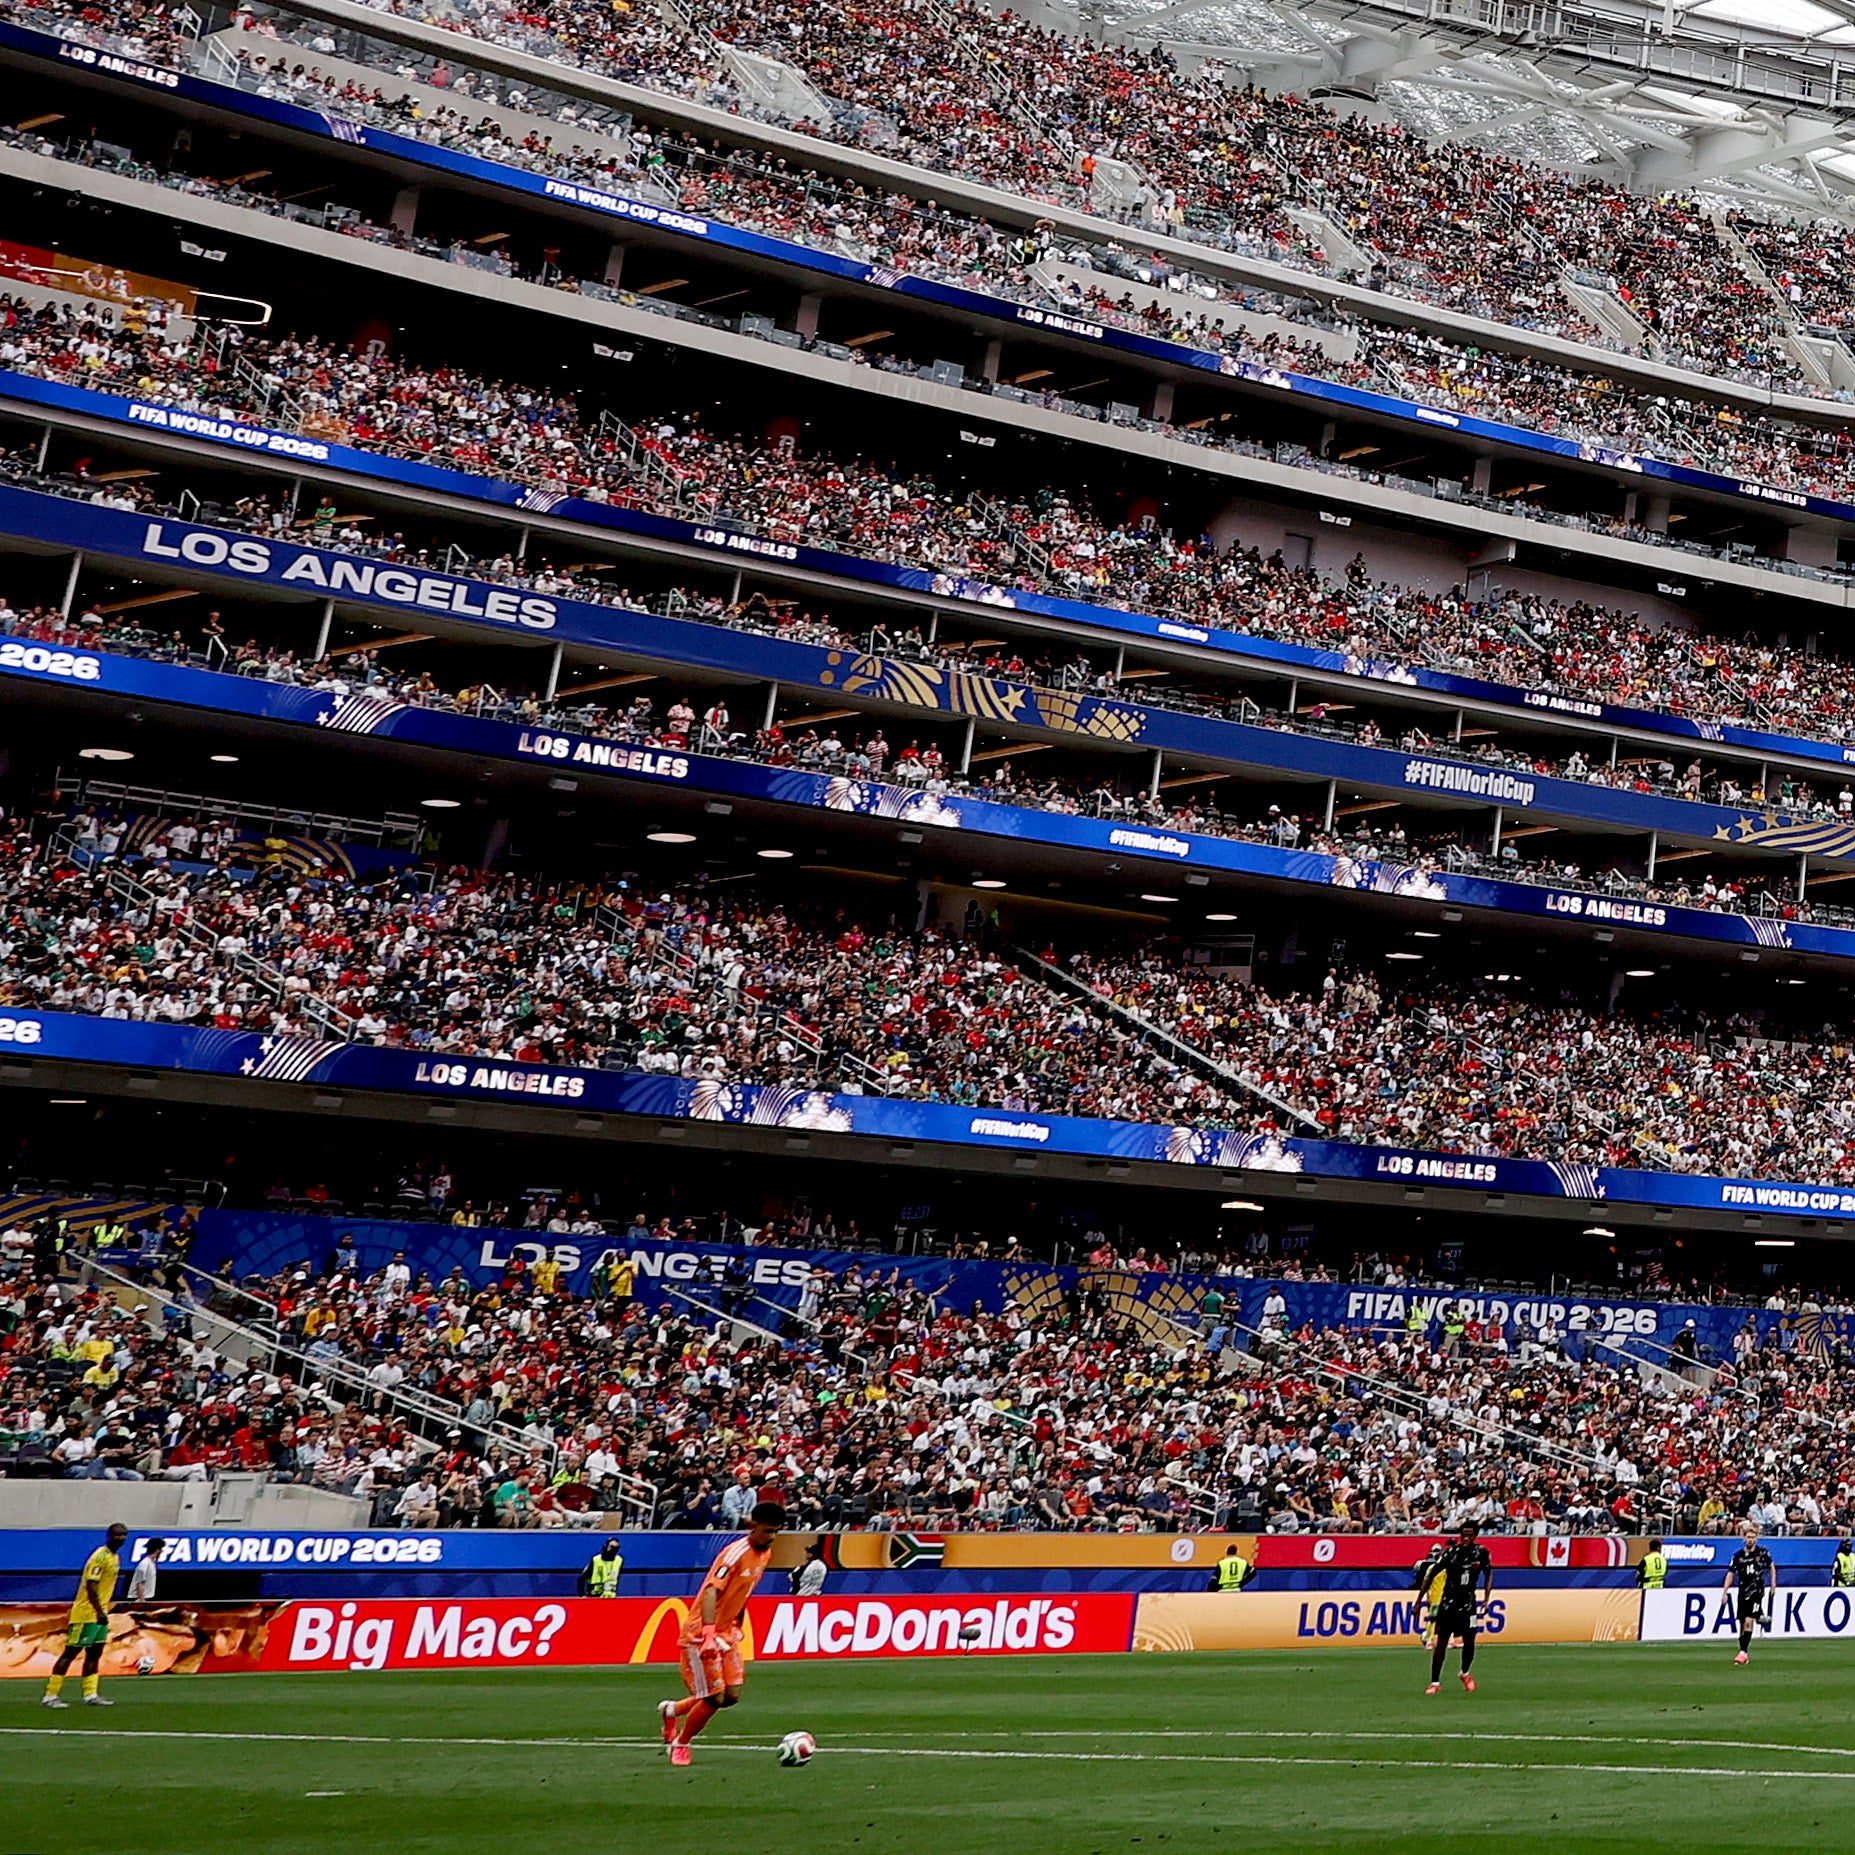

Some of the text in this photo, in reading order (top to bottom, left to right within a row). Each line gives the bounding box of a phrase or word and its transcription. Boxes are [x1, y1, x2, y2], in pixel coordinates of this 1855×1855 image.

[59, 44, 179, 87] LOS ANGELES
[545, 181, 707, 234] FIFA WORLD CUP 2026
[1017, 308, 1103, 338] LOS ANGELES
[129, 405, 328, 459] FIFA WORLD CUP 2026
[1739, 484, 1806, 506] LOS ANGELES
[694, 528, 797, 559] LOS ANGELES
[143, 524, 556, 628] LOS ANGELES
[0, 644, 99, 679] 2026
[1524, 693, 1601, 716] LOS ANGELES
[518, 733, 688, 778] LOS ANGELES
[1405, 761, 1534, 805] #FIFAWorldCup
[1546, 894, 1665, 925] LOS ANGELES
[415, 1063, 584, 1097] LOS ANGELES
[1377, 1156, 1496, 1181] LOS ANGELES
[1722, 1186, 1754, 1203] FIFA
[1756, 1188, 1809, 1207] WORLD
[1810, 1193, 1839, 1209] CUP
[131, 1537, 443, 1563] FFA WORLD CUP 2026
[1313, 1538, 1337, 1563] 0
[763, 1598, 1076, 1656] McDonald's
[1297, 1601, 1360, 1637] LOS
[1683, 1591, 1807, 1635] BAK
[288, 1602, 567, 1671] Big Mac?
